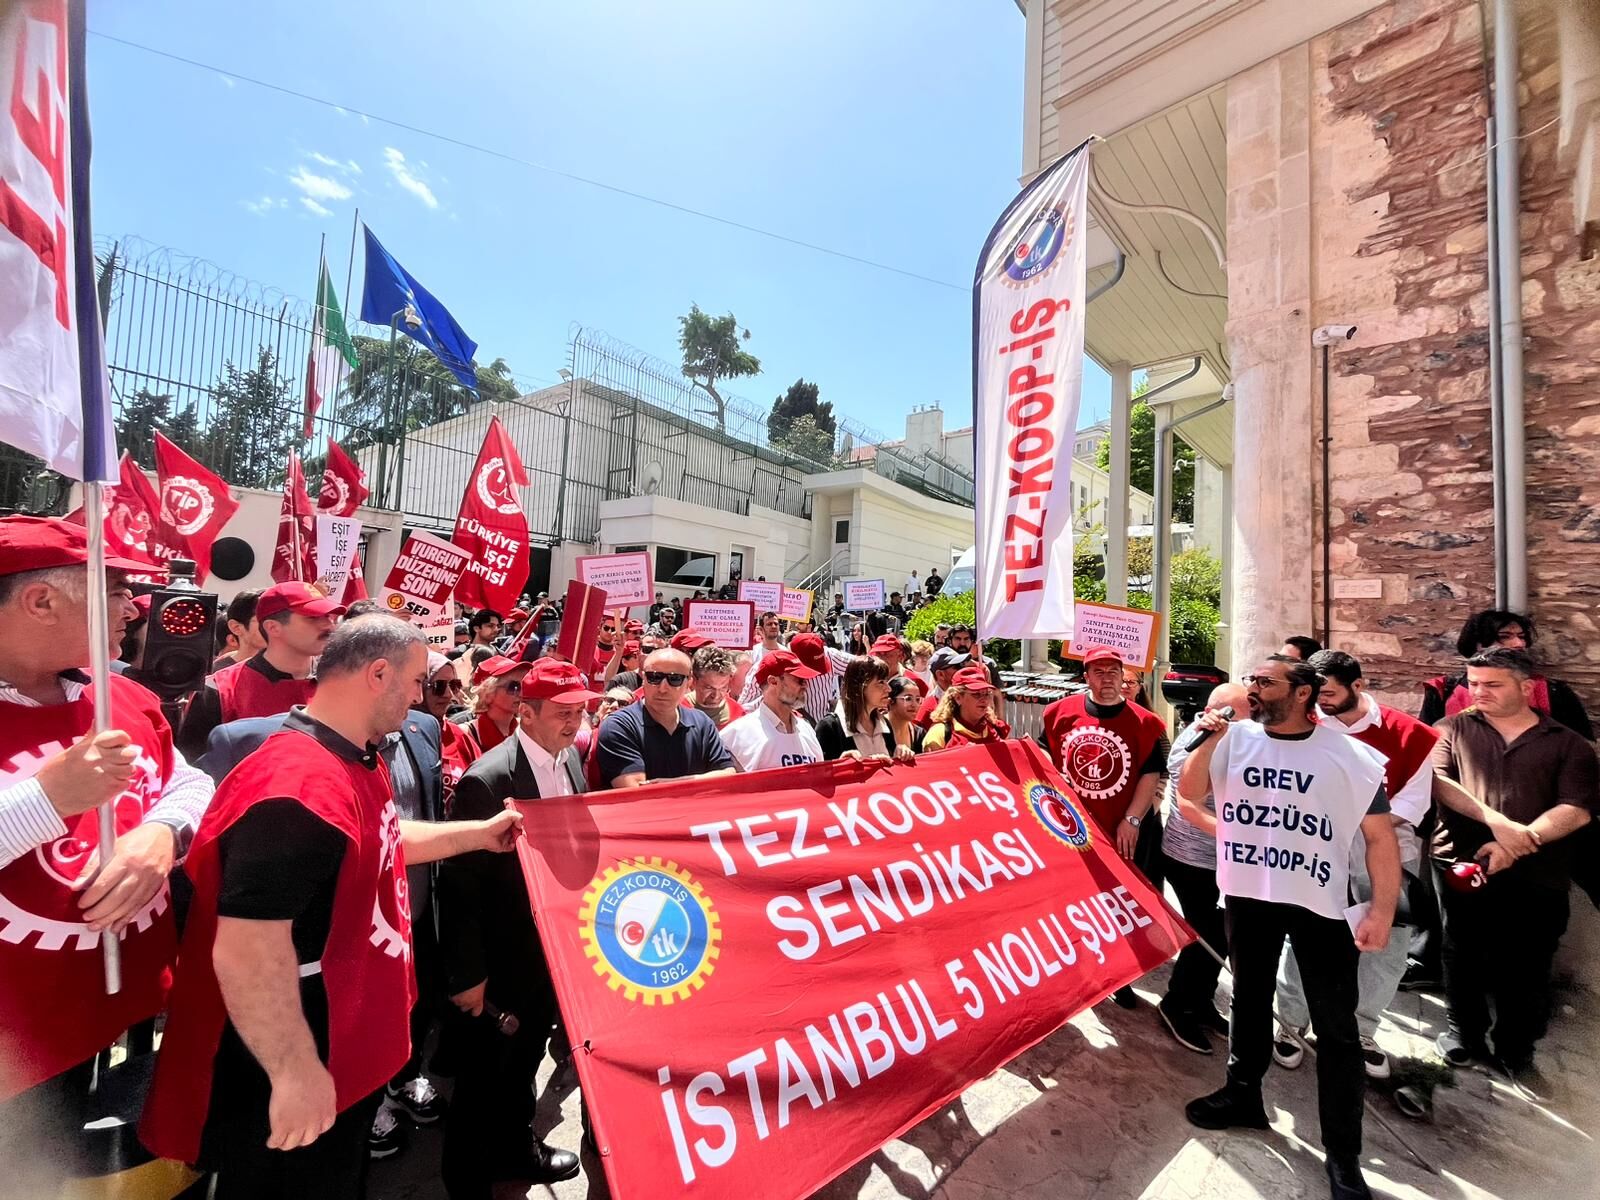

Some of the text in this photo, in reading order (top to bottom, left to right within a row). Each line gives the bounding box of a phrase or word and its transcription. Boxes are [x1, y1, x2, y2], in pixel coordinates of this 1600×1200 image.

[1022, 263, 1042, 278] 1962
[999, 298, 1070, 602] TEZ-KOOP-İŞ
[170, 488, 199, 510] TİP
[332, 521, 350, 538] EŞİT
[459, 517, 520, 553] TÜRKİYE
[335, 537, 348, 554] İŞE
[410, 540, 463, 571] VURGUN
[483, 544, 515, 569] İŞÇİ
[331, 553, 347, 570] EŞİT
[395, 554, 459, 587] DÜZENİNE
[400, 573, 441, 599] SON!
[404, 600, 430, 617] SEP
[1082, 626, 1140, 642] DAYANIŞMADA
[1085, 619, 1114, 629] SINIFTA
[428, 635, 447, 644] SEP
[1117, 641, 1131, 649] AL!
[1088, 764, 1102, 778] tk
[1243, 766, 1314, 794] GREV
[1081, 780, 1101, 790] 1962
[690, 766, 1019, 876] TEZ-KOOP-İŞ
[1222, 799, 1333, 841] GÖZCÜSÜ
[766, 828, 1046, 961] SENDİKASI
[651, 928, 679, 958] tk
[651, 962, 688, 985] 1962
[658, 886, 1152, 1184] İSTANBUL 5 NOLU ŞUBE
